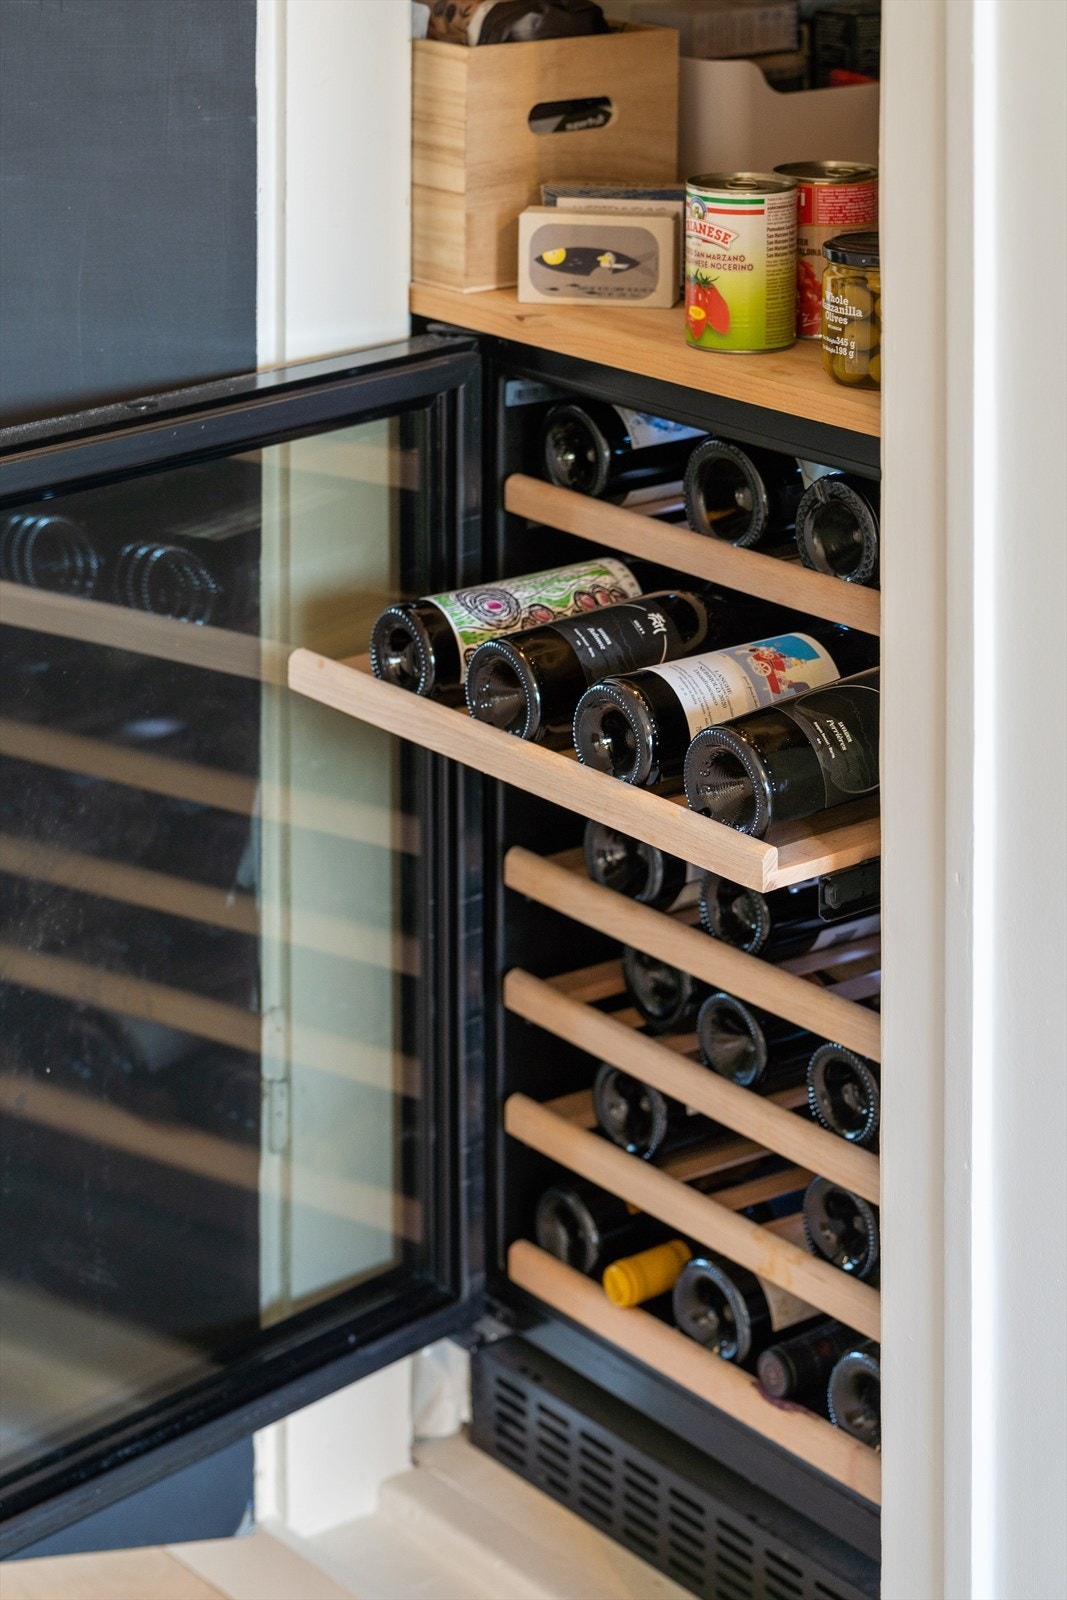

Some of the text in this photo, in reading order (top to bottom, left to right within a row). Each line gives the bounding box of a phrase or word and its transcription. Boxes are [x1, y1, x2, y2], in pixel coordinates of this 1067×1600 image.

[706, 253, 746, 263] MARZANO
[710, 262, 754, 272] NOCERINO
[825, 311, 848, 325] Olives
[836, 336, 849, 347] 345
[850, 341, 856, 350] g
[835, 346, 848, 356] 198
[849, 350, 855, 359] g
[697, 666, 728, 709] NEBBIOLO 2020
[714, 670, 732, 694] LANGHE
[826, 720, 847, 751] Perrières
